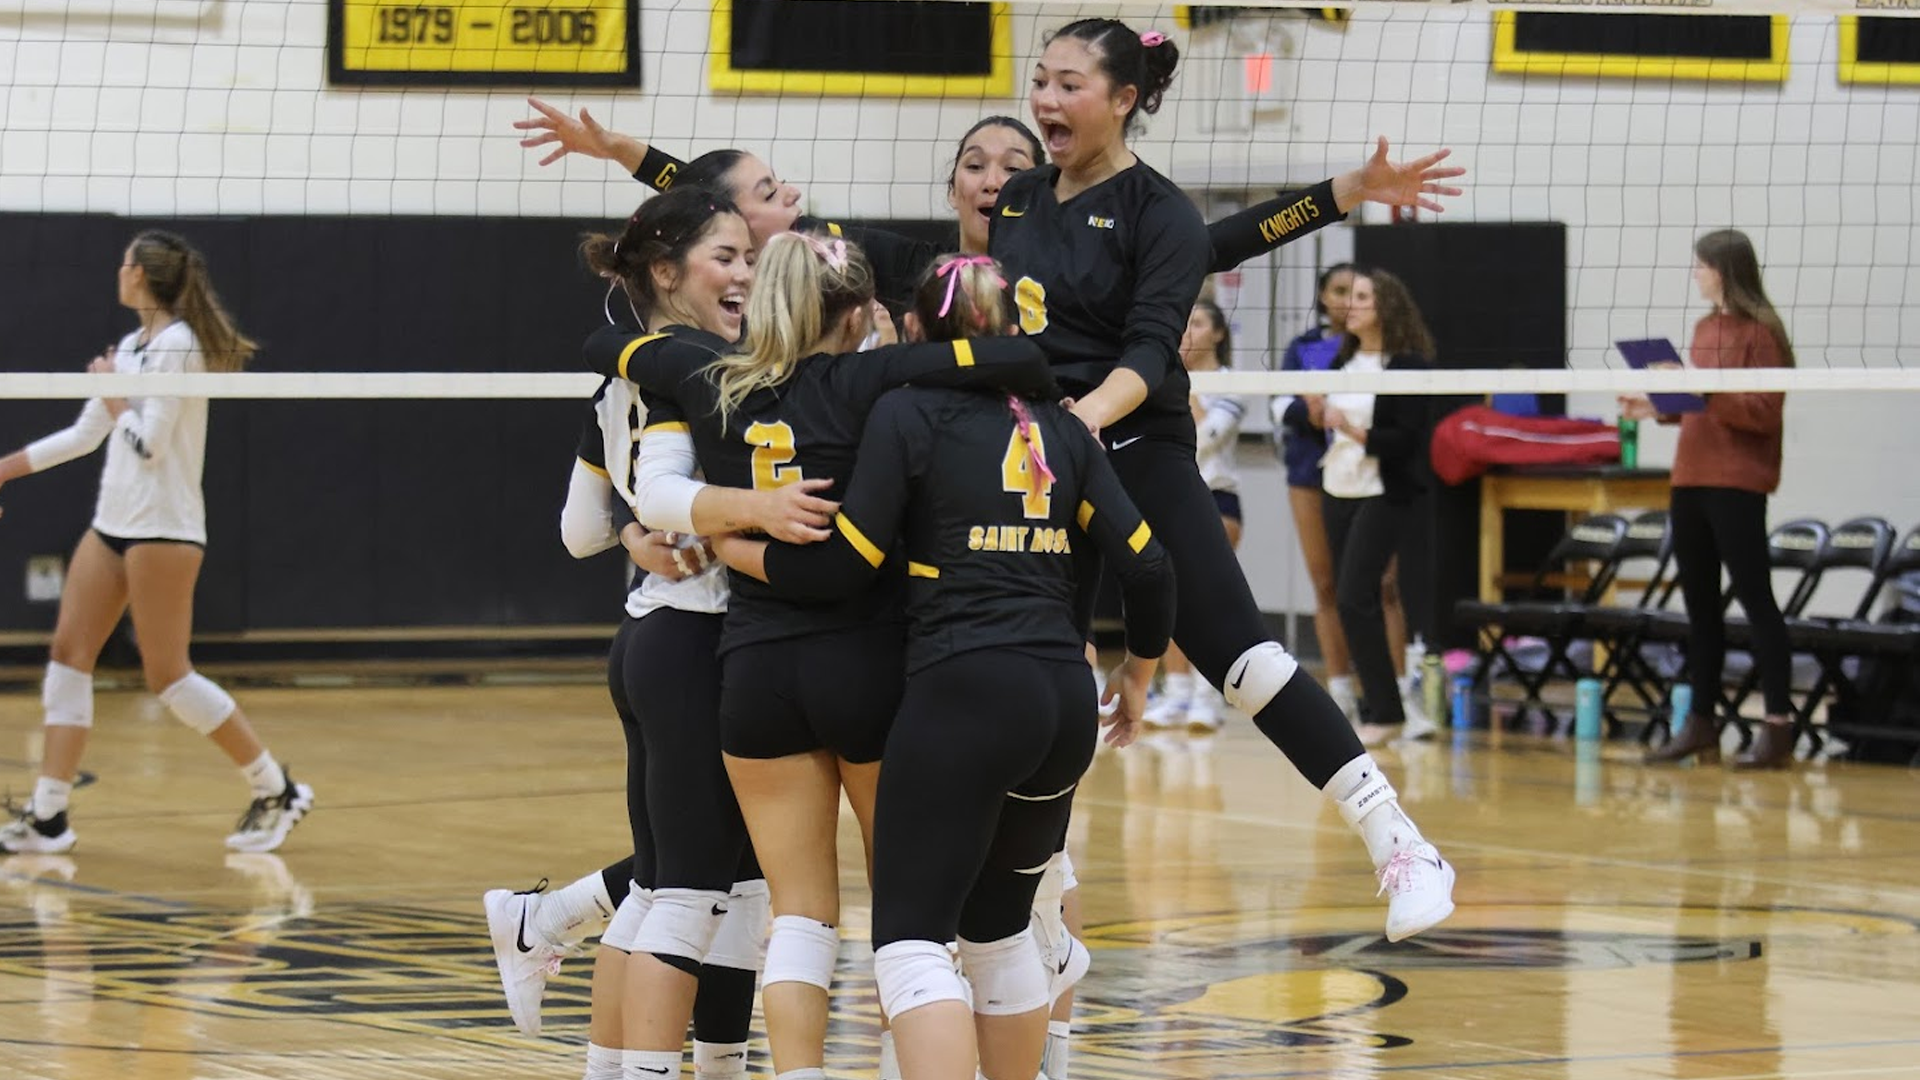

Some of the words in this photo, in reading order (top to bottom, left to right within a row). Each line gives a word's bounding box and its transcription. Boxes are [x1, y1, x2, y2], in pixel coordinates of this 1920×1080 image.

[379, 7, 454, 44] 1979
[511, 8, 597, 46] 2006
[1258, 195, 1320, 244] KNIGHTS
[744, 419, 804, 491] 2
[1001, 421, 1052, 520] 4
[968, 525, 1029, 552] SAINT
[1029, 526, 1072, 554] ROS
